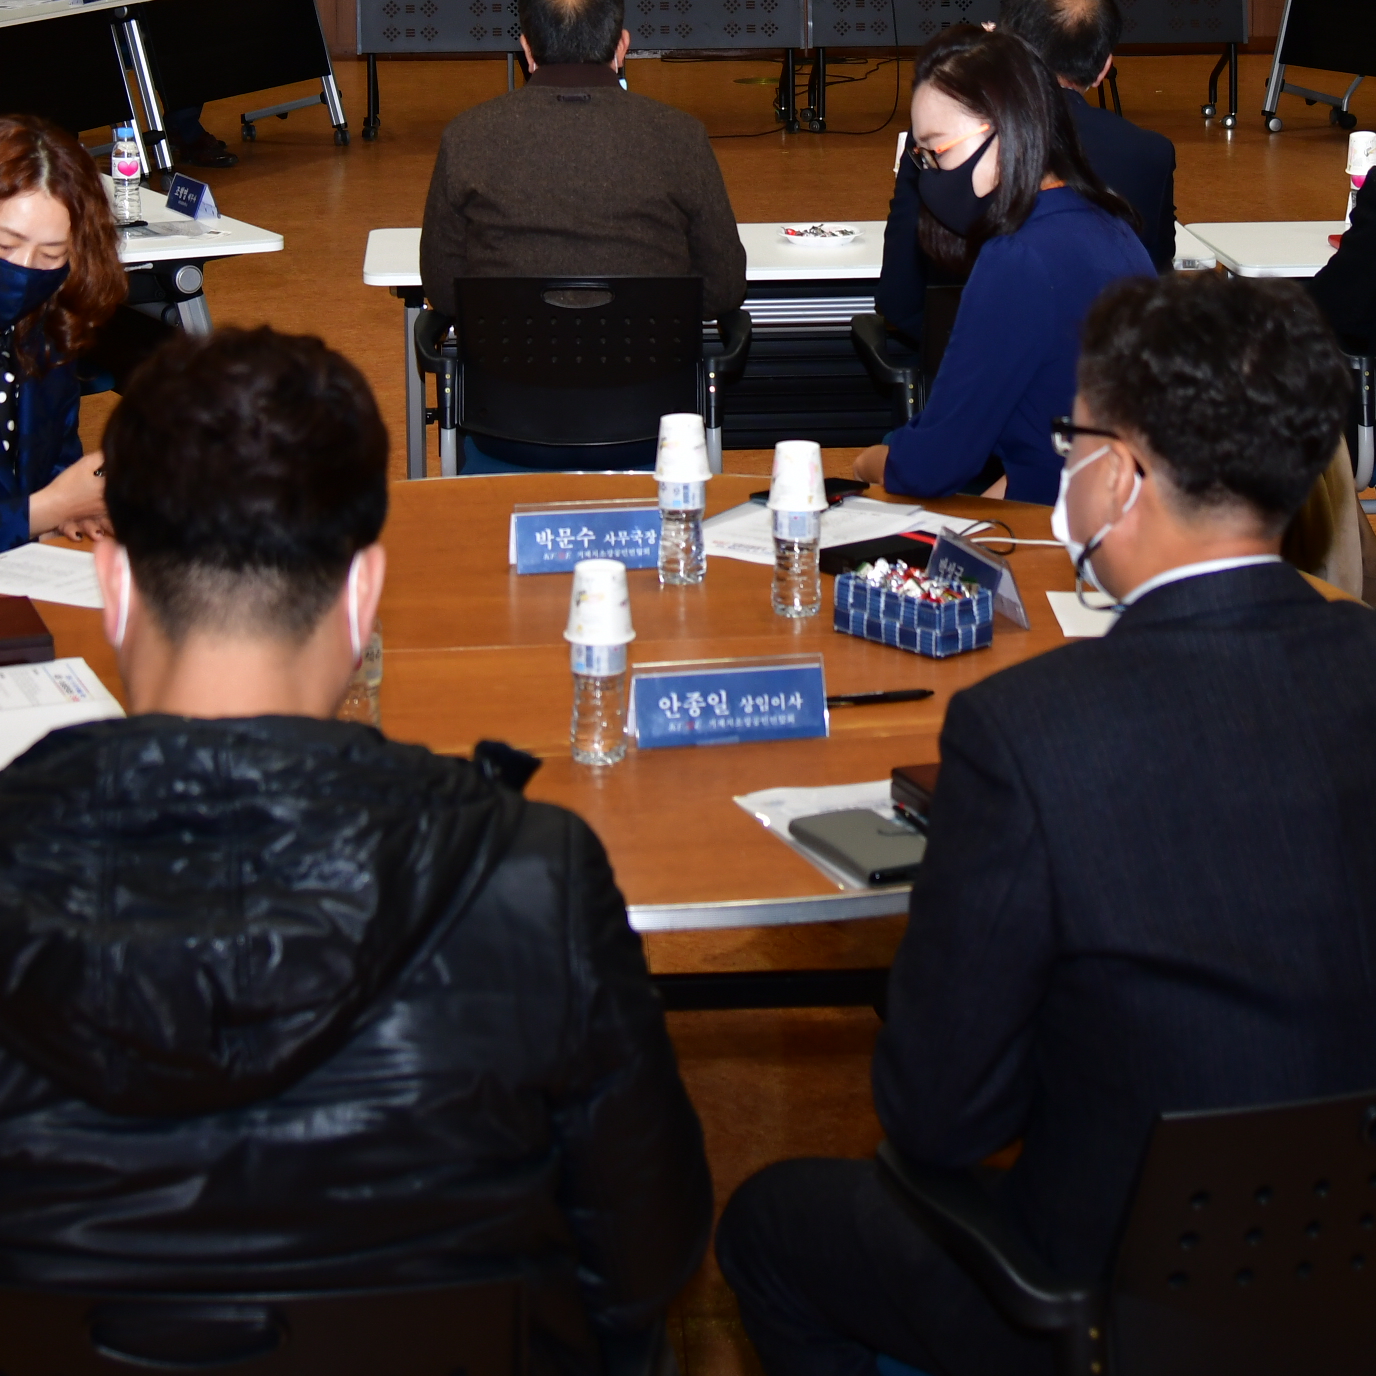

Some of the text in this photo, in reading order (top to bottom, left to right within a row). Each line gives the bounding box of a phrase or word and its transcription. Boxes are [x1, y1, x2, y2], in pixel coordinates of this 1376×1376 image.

[535, 526, 657, 550] 박문수 사무국장
[658, 689, 803, 719] 안종일 상임이사
